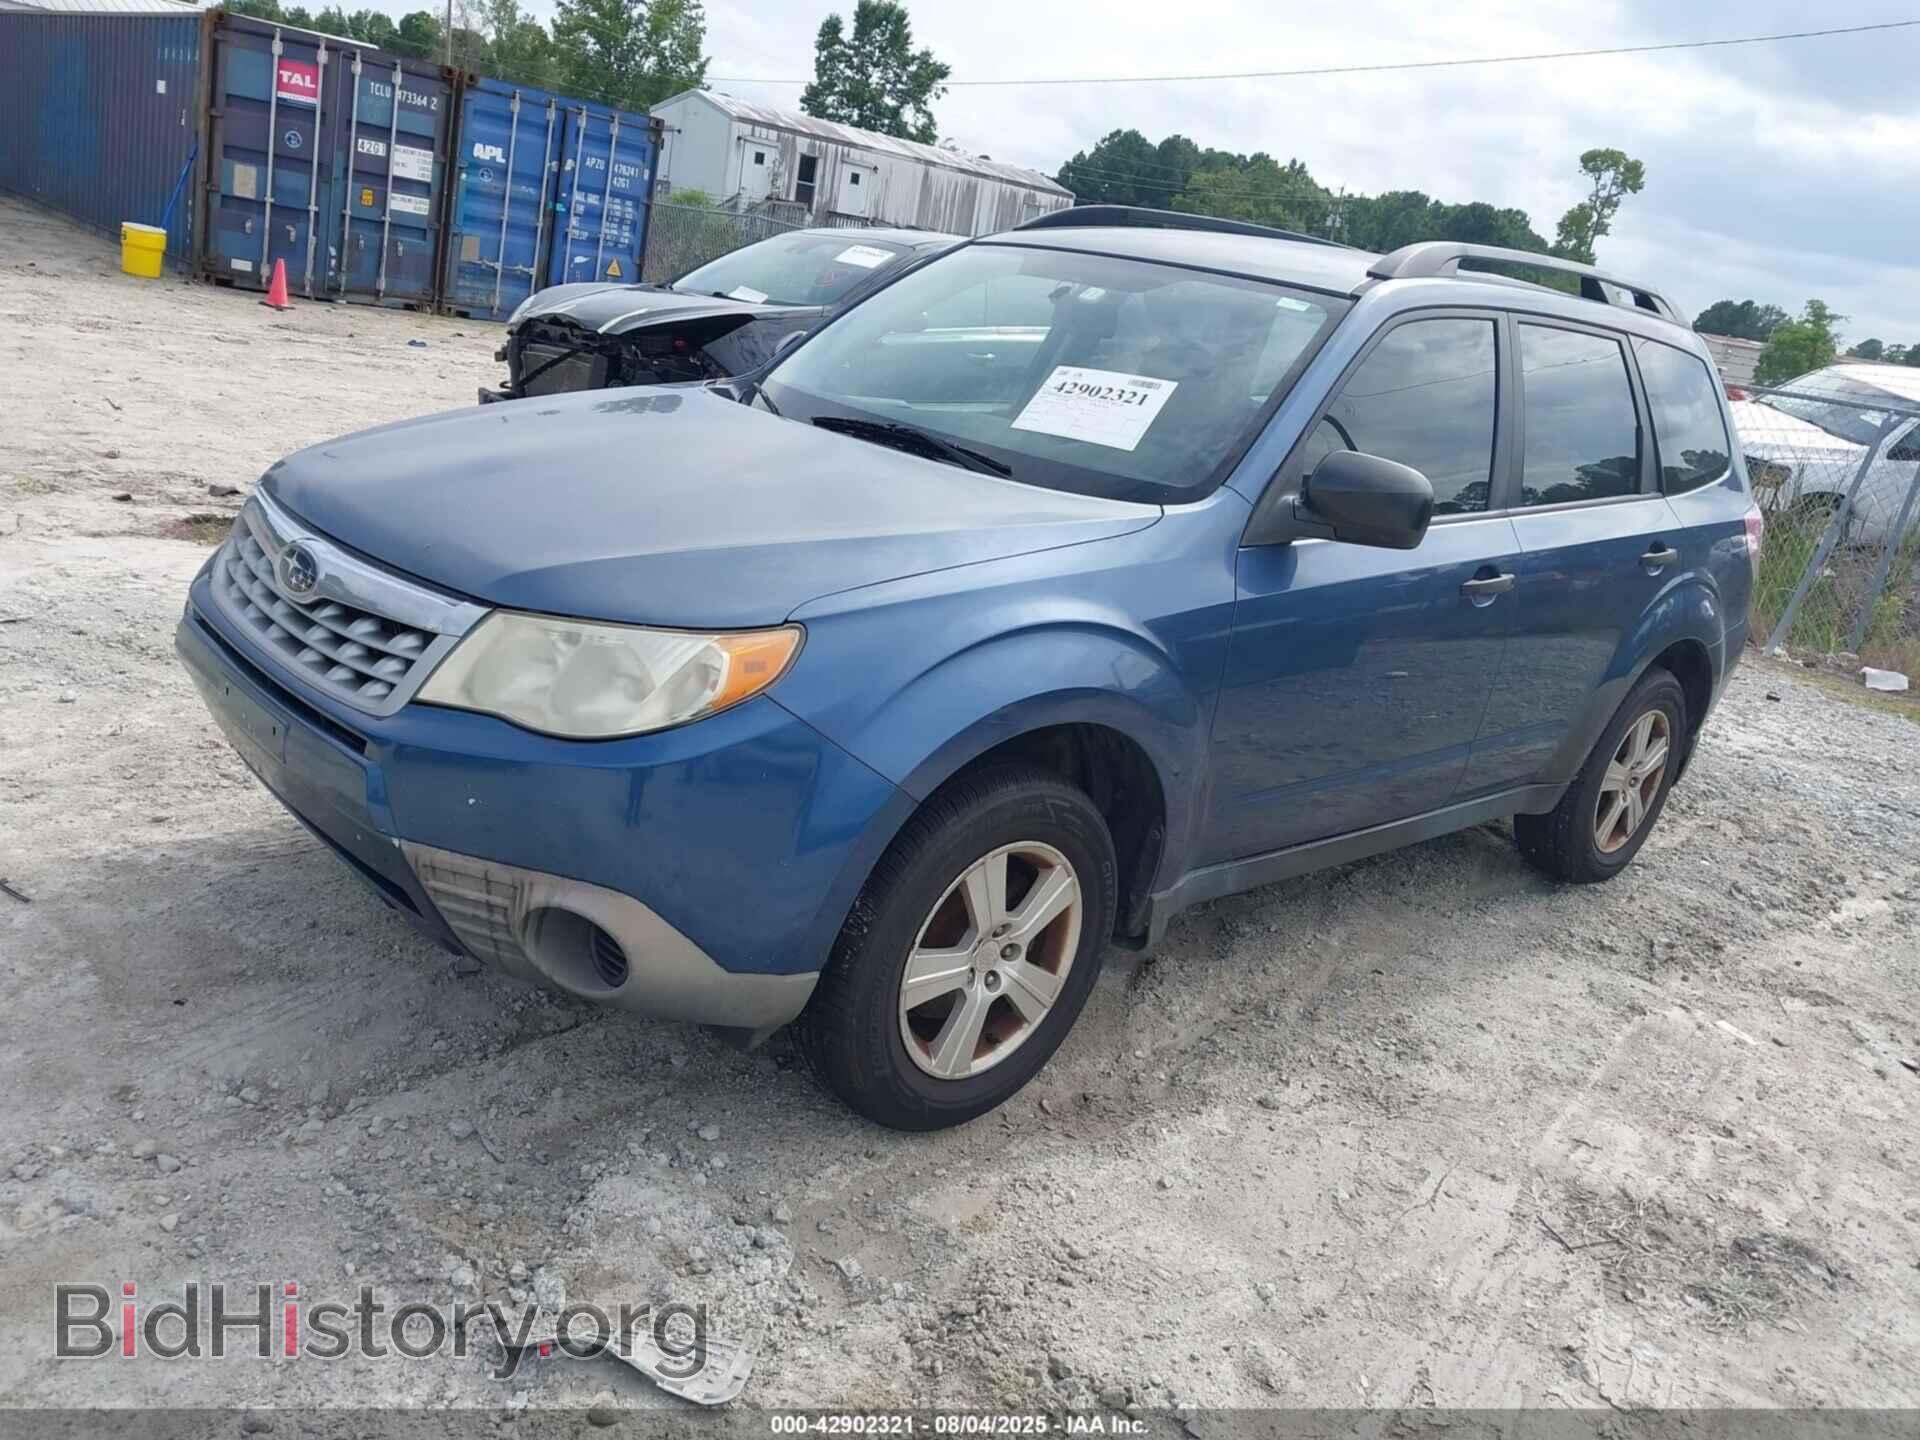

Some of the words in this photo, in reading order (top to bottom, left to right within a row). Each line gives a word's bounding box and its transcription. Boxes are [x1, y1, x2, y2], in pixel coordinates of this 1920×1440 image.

[279, 70, 316, 88] TAL
[370, 82, 391, 98] TCLU
[473, 142, 506, 164] APL
[1053, 381, 1151, 406] 42902321
